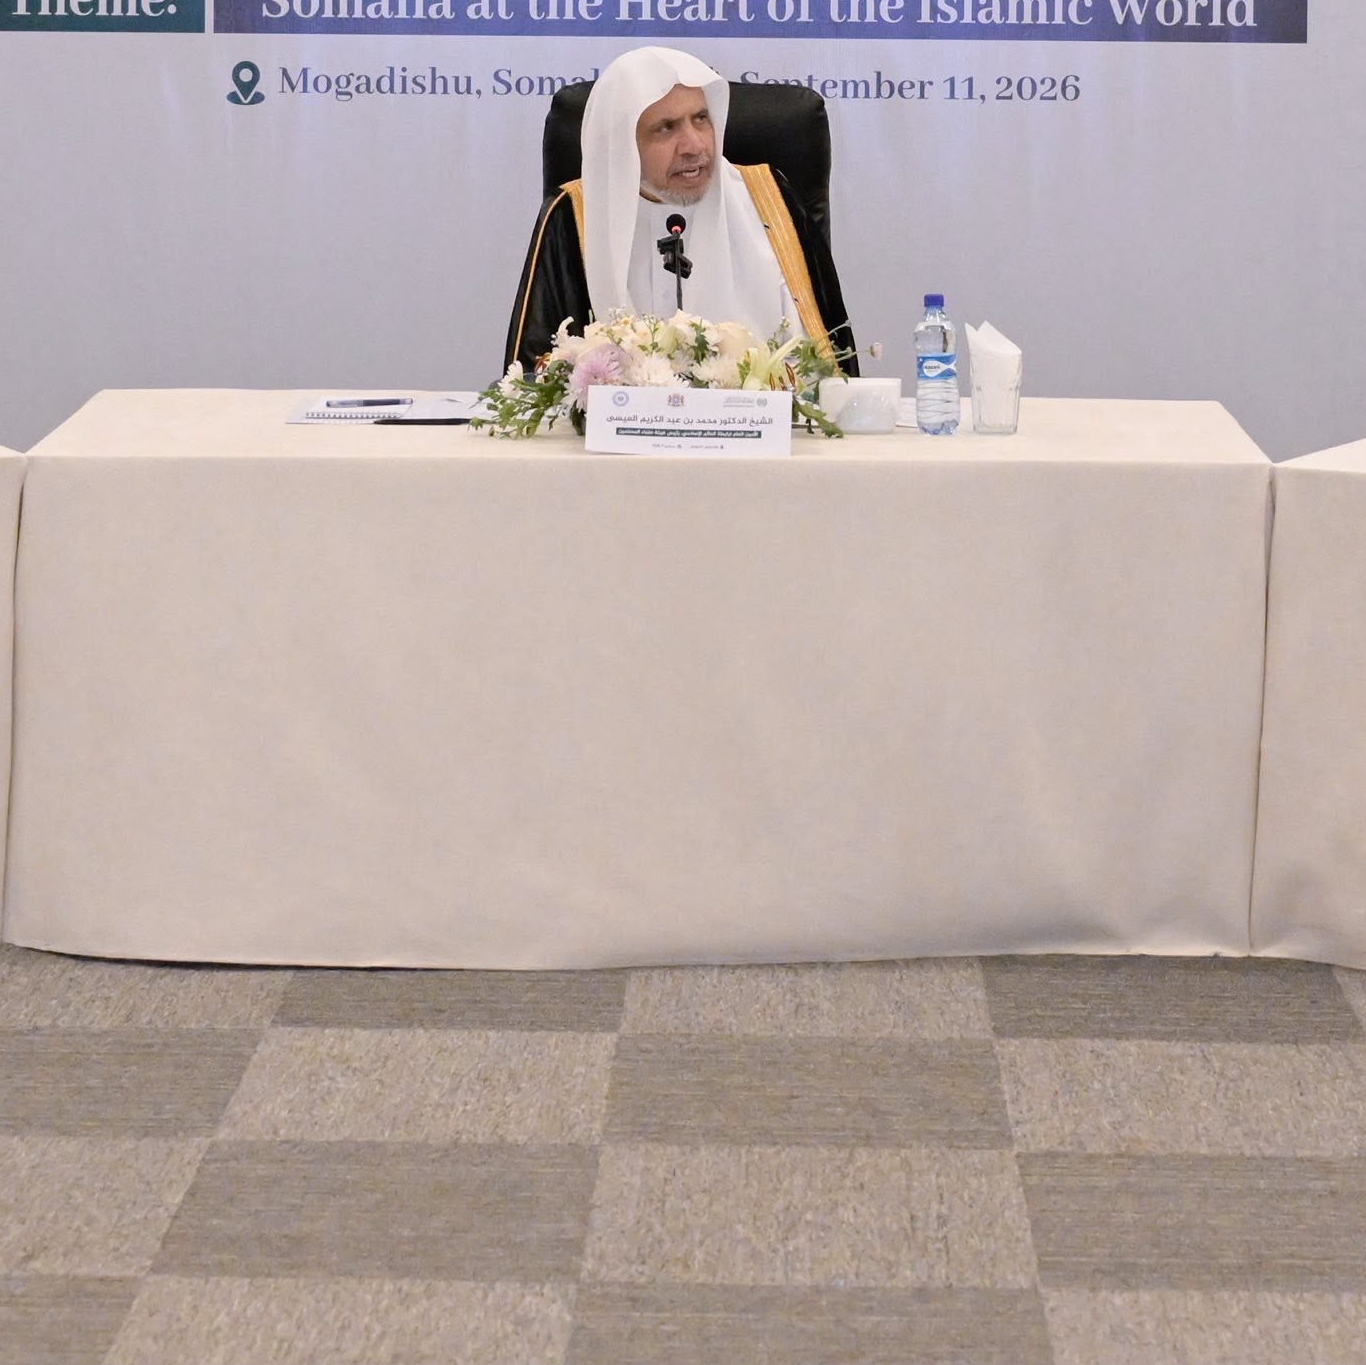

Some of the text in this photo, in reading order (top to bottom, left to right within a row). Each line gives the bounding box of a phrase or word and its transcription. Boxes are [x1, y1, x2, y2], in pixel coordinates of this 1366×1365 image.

[278, 65, 482, 102] Mogadishu,
[942, 75, 986, 105] 11,
[995, 74, 1081, 102] 2026
[639, 415, 664, 425] الكريم
[719, 417, 746, 427] الدكتور
[749, 416, 774, 428] الشيخ
